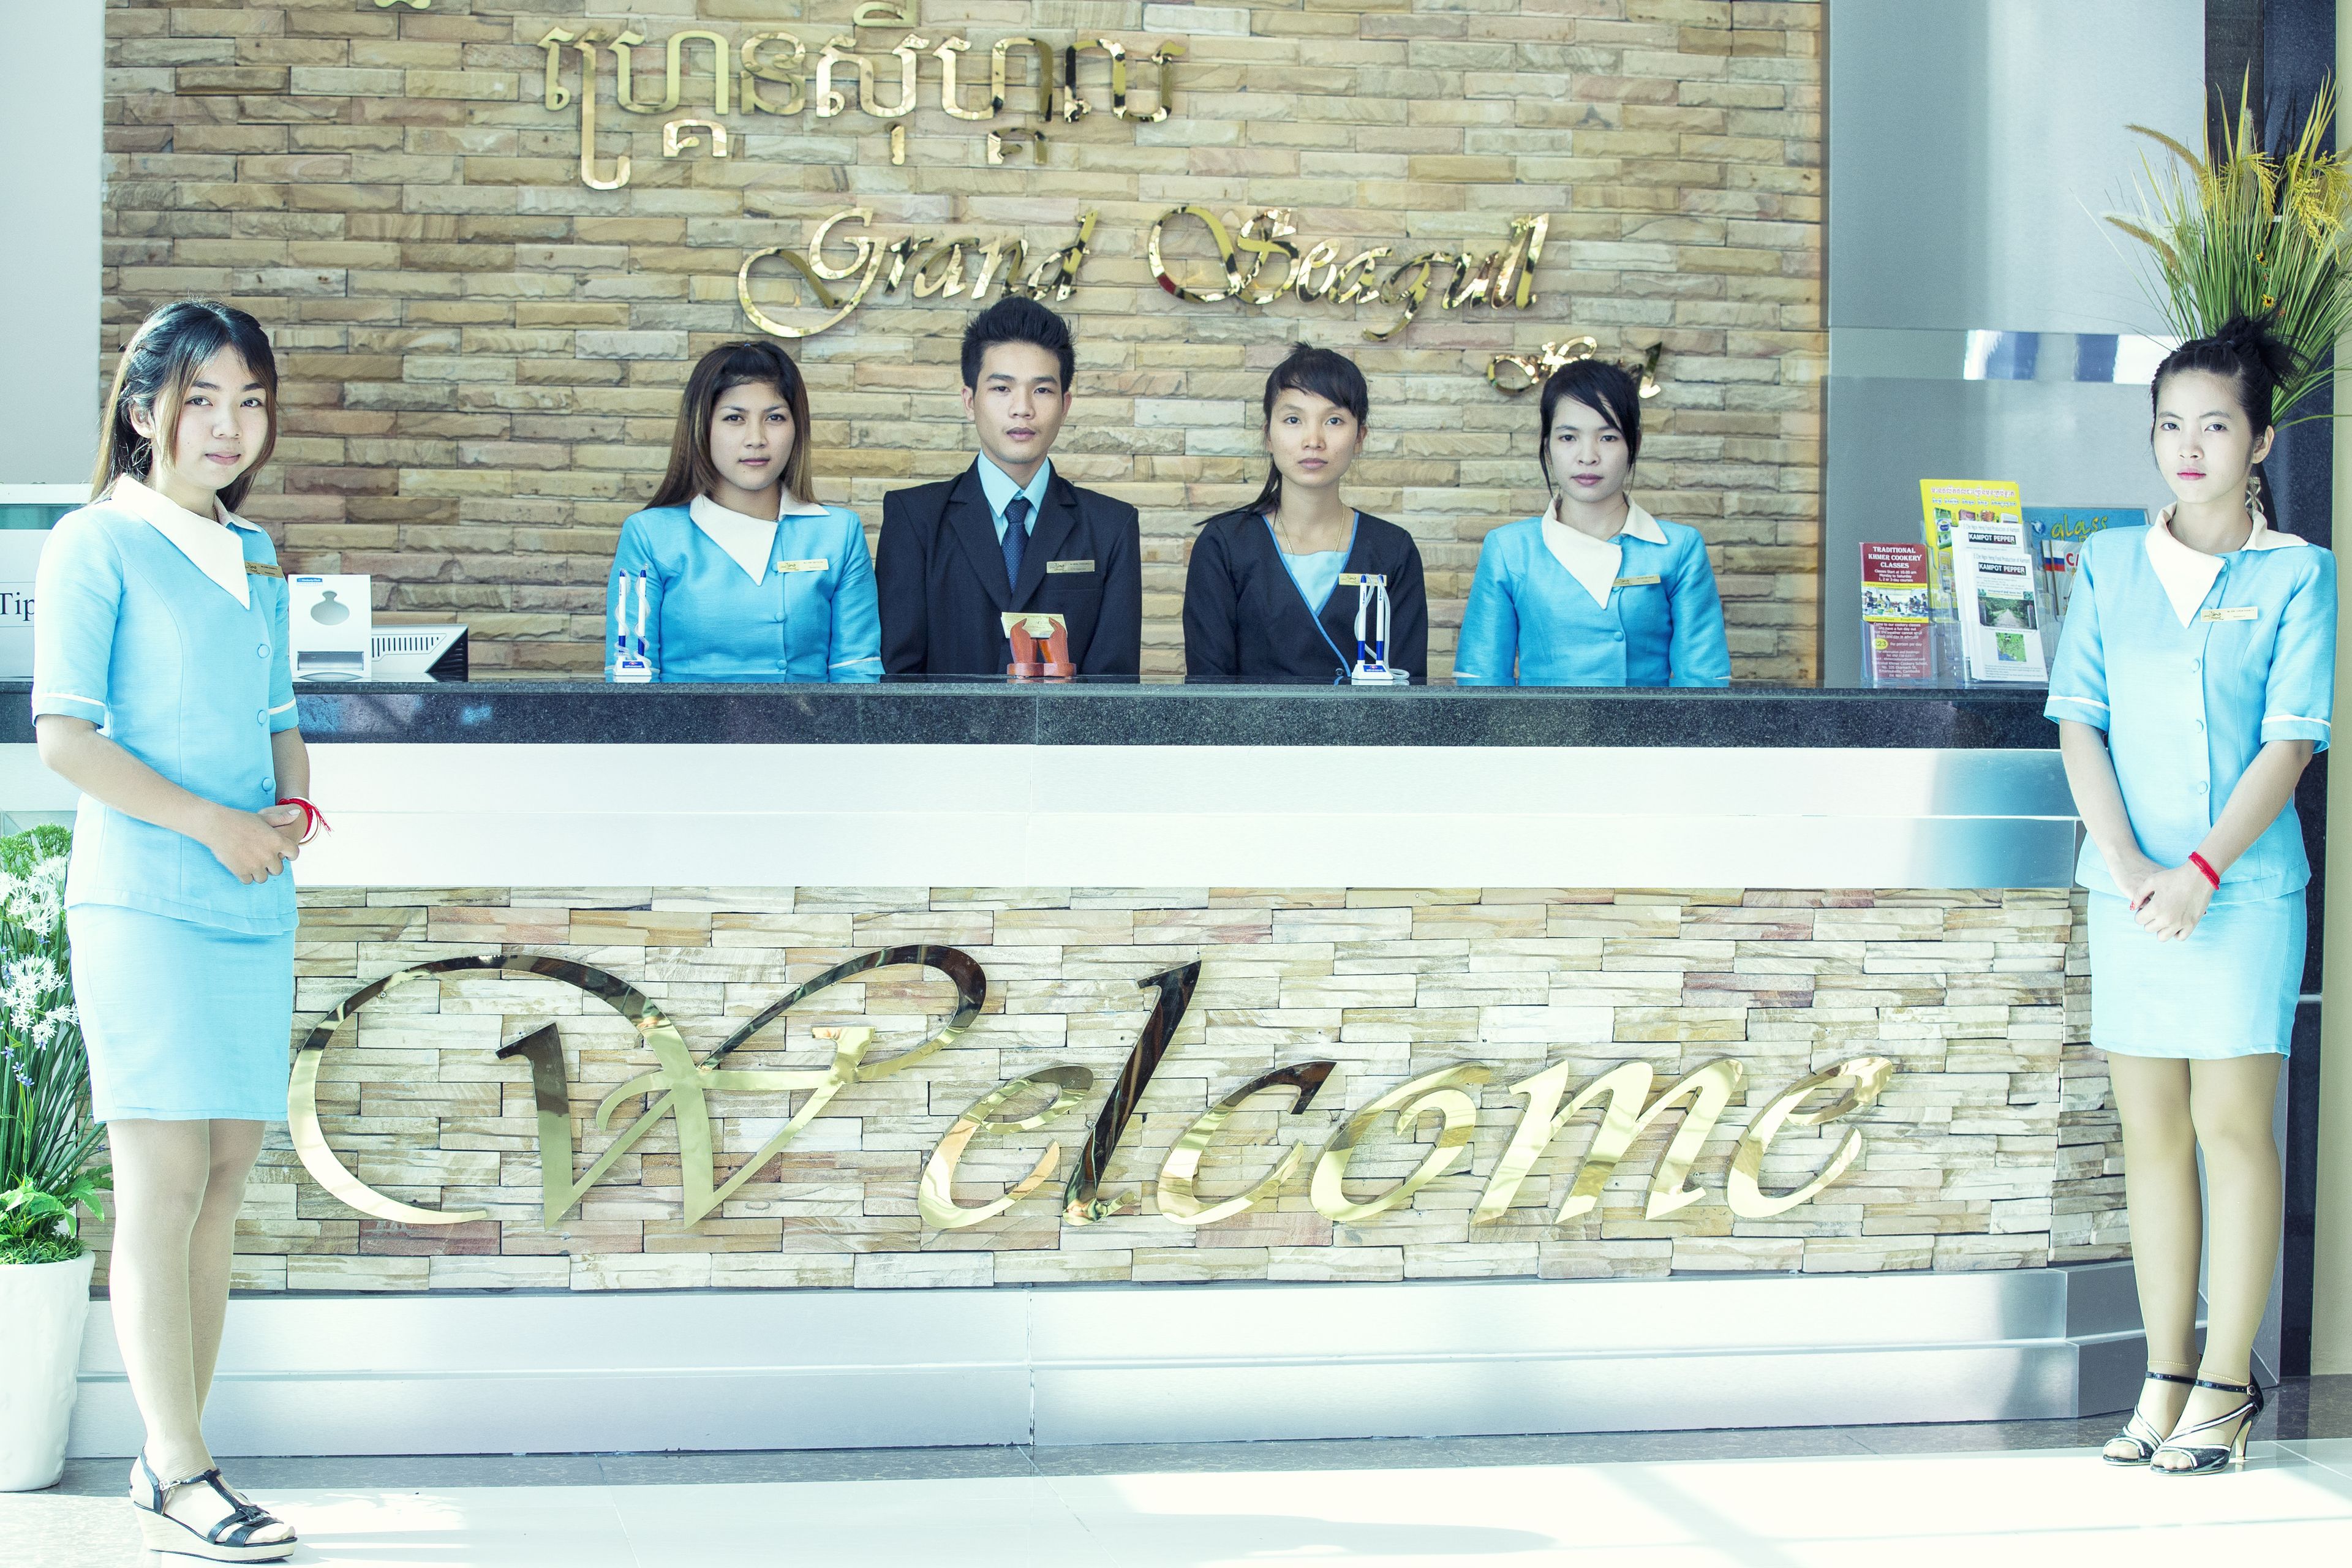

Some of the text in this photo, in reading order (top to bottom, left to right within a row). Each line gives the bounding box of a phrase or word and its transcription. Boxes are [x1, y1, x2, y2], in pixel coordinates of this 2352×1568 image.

[737, 206, 1549, 342] Grand Seagull
[288, 944, 1901, 1230] Welcome
